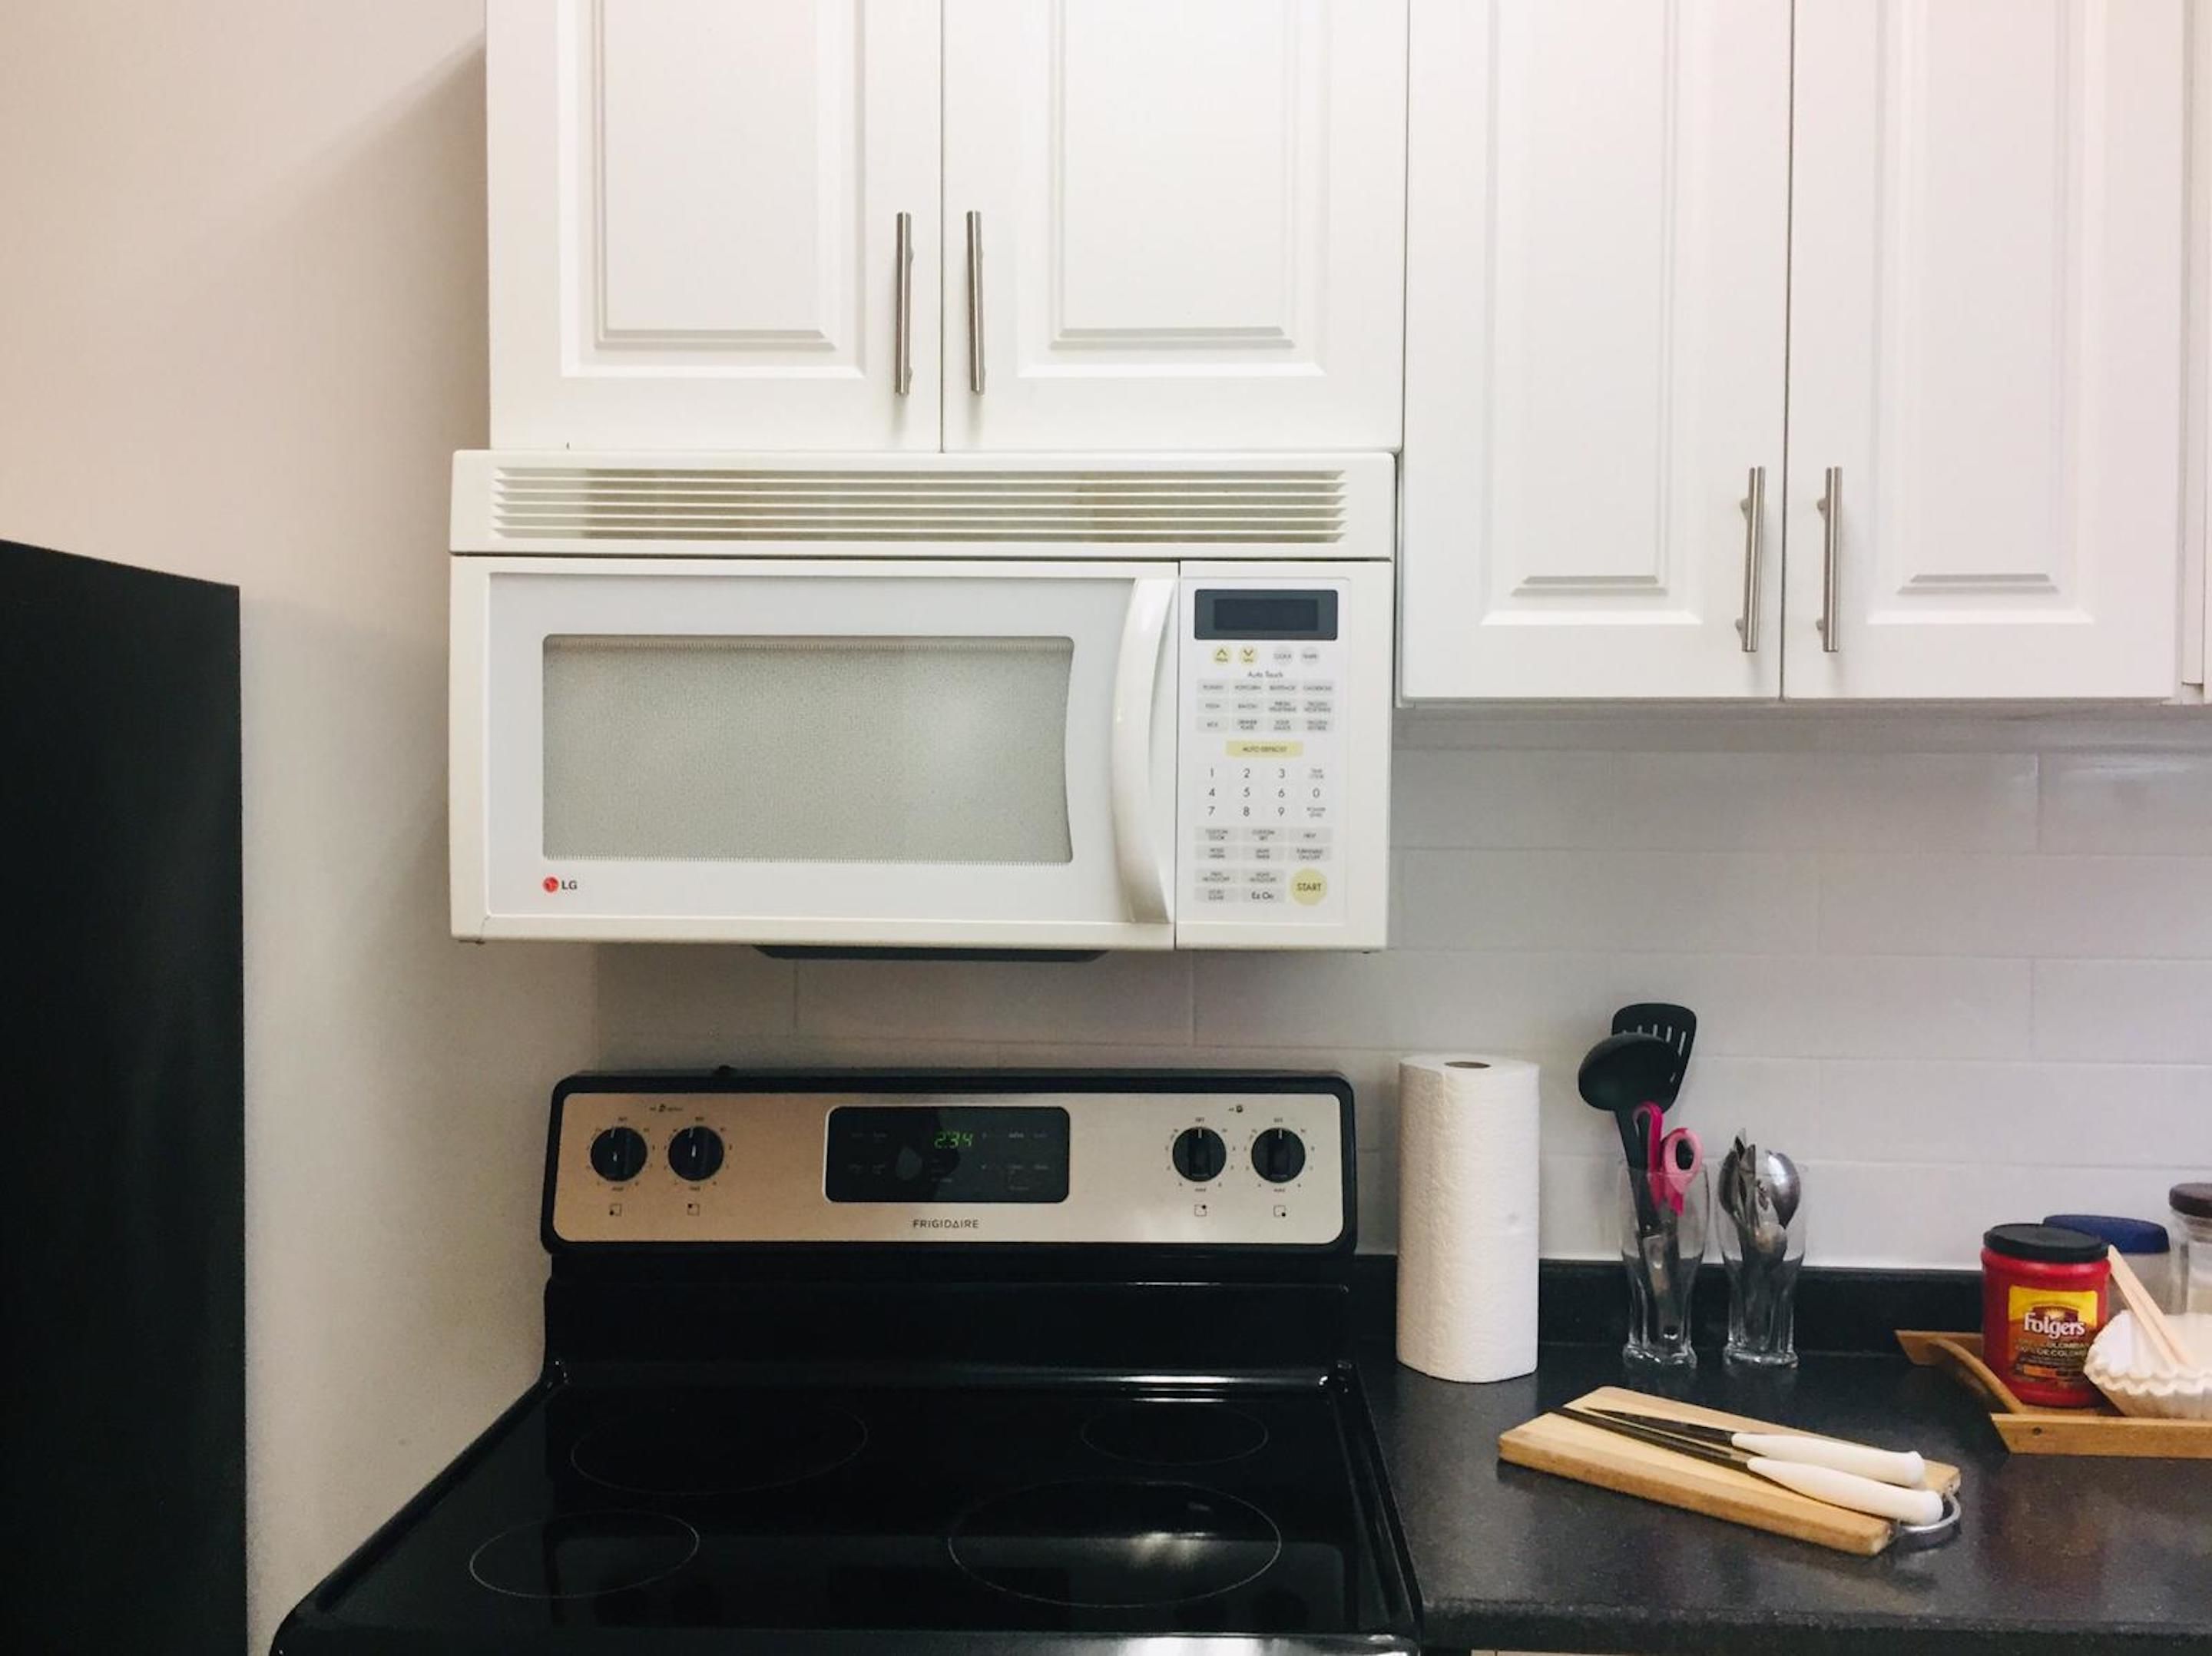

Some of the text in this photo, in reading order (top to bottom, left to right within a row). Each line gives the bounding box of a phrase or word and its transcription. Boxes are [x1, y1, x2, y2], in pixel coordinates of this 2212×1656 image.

[1210, 767, 1214, 777] 1
[1243, 768, 1250, 778] 2
[1278, 768, 1285, 778] 3
[1208, 788, 1216, 797] 4
[1243, 787, 1250, 797] 5
[1278, 788, 1285, 798] 6
[1313, 788, 1320, 798] 0
[1208, 806, 1215, 816] 7
[1243, 806, 1250, 816] 8
[1278, 806, 1285, 816] 9
[561, 880, 578, 890] LG
[1296, 883, 1322, 892] START
[912, 1219, 979, 1228] FRIGIDAIRE
[2023, 1312, 2086, 1340] Folgers
